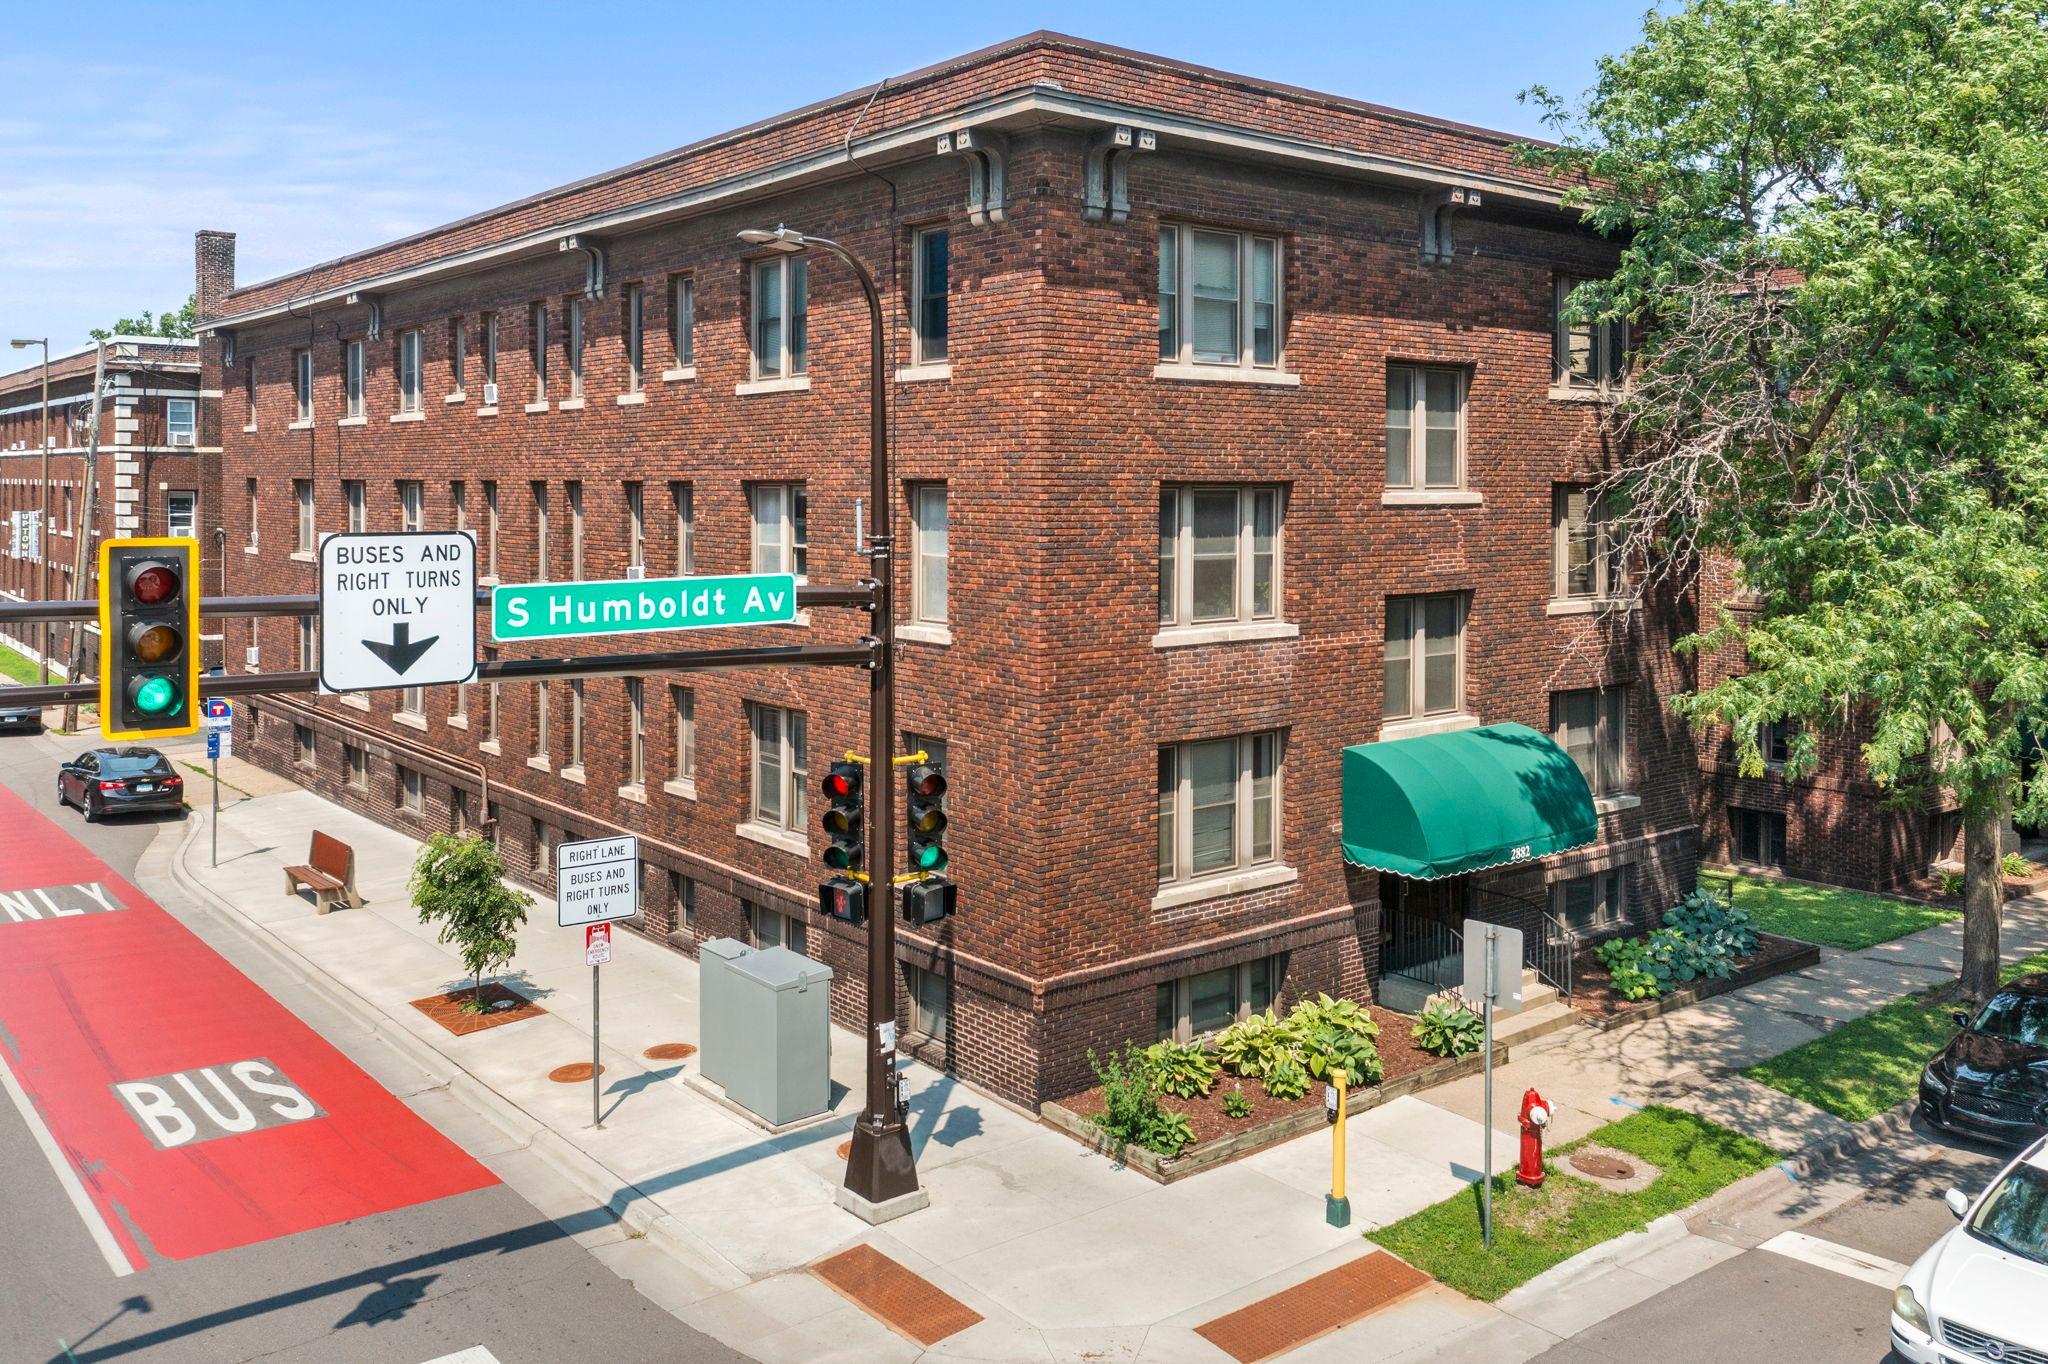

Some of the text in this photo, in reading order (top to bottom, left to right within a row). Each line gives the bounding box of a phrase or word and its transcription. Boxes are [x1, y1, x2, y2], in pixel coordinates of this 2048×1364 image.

[21, 513, 29, 557] UPTOWN
[337, 544, 461, 564] BUSES AND
[337, 570, 460, 591] RIGHT TURNS
[372, 597, 428, 616] ONLY
[507, 586, 785, 627] S Humboldt Av
[569, 845, 626, 862] RIGHT LANE
[1511, 845, 1530, 860] 2882
[571, 867, 625, 885] BUSES AND
[566, 883, 630, 902] RIGHT TURNS
[587, 902, 609, 915] ONLY
[116, 1061, 316, 1148] BUS
